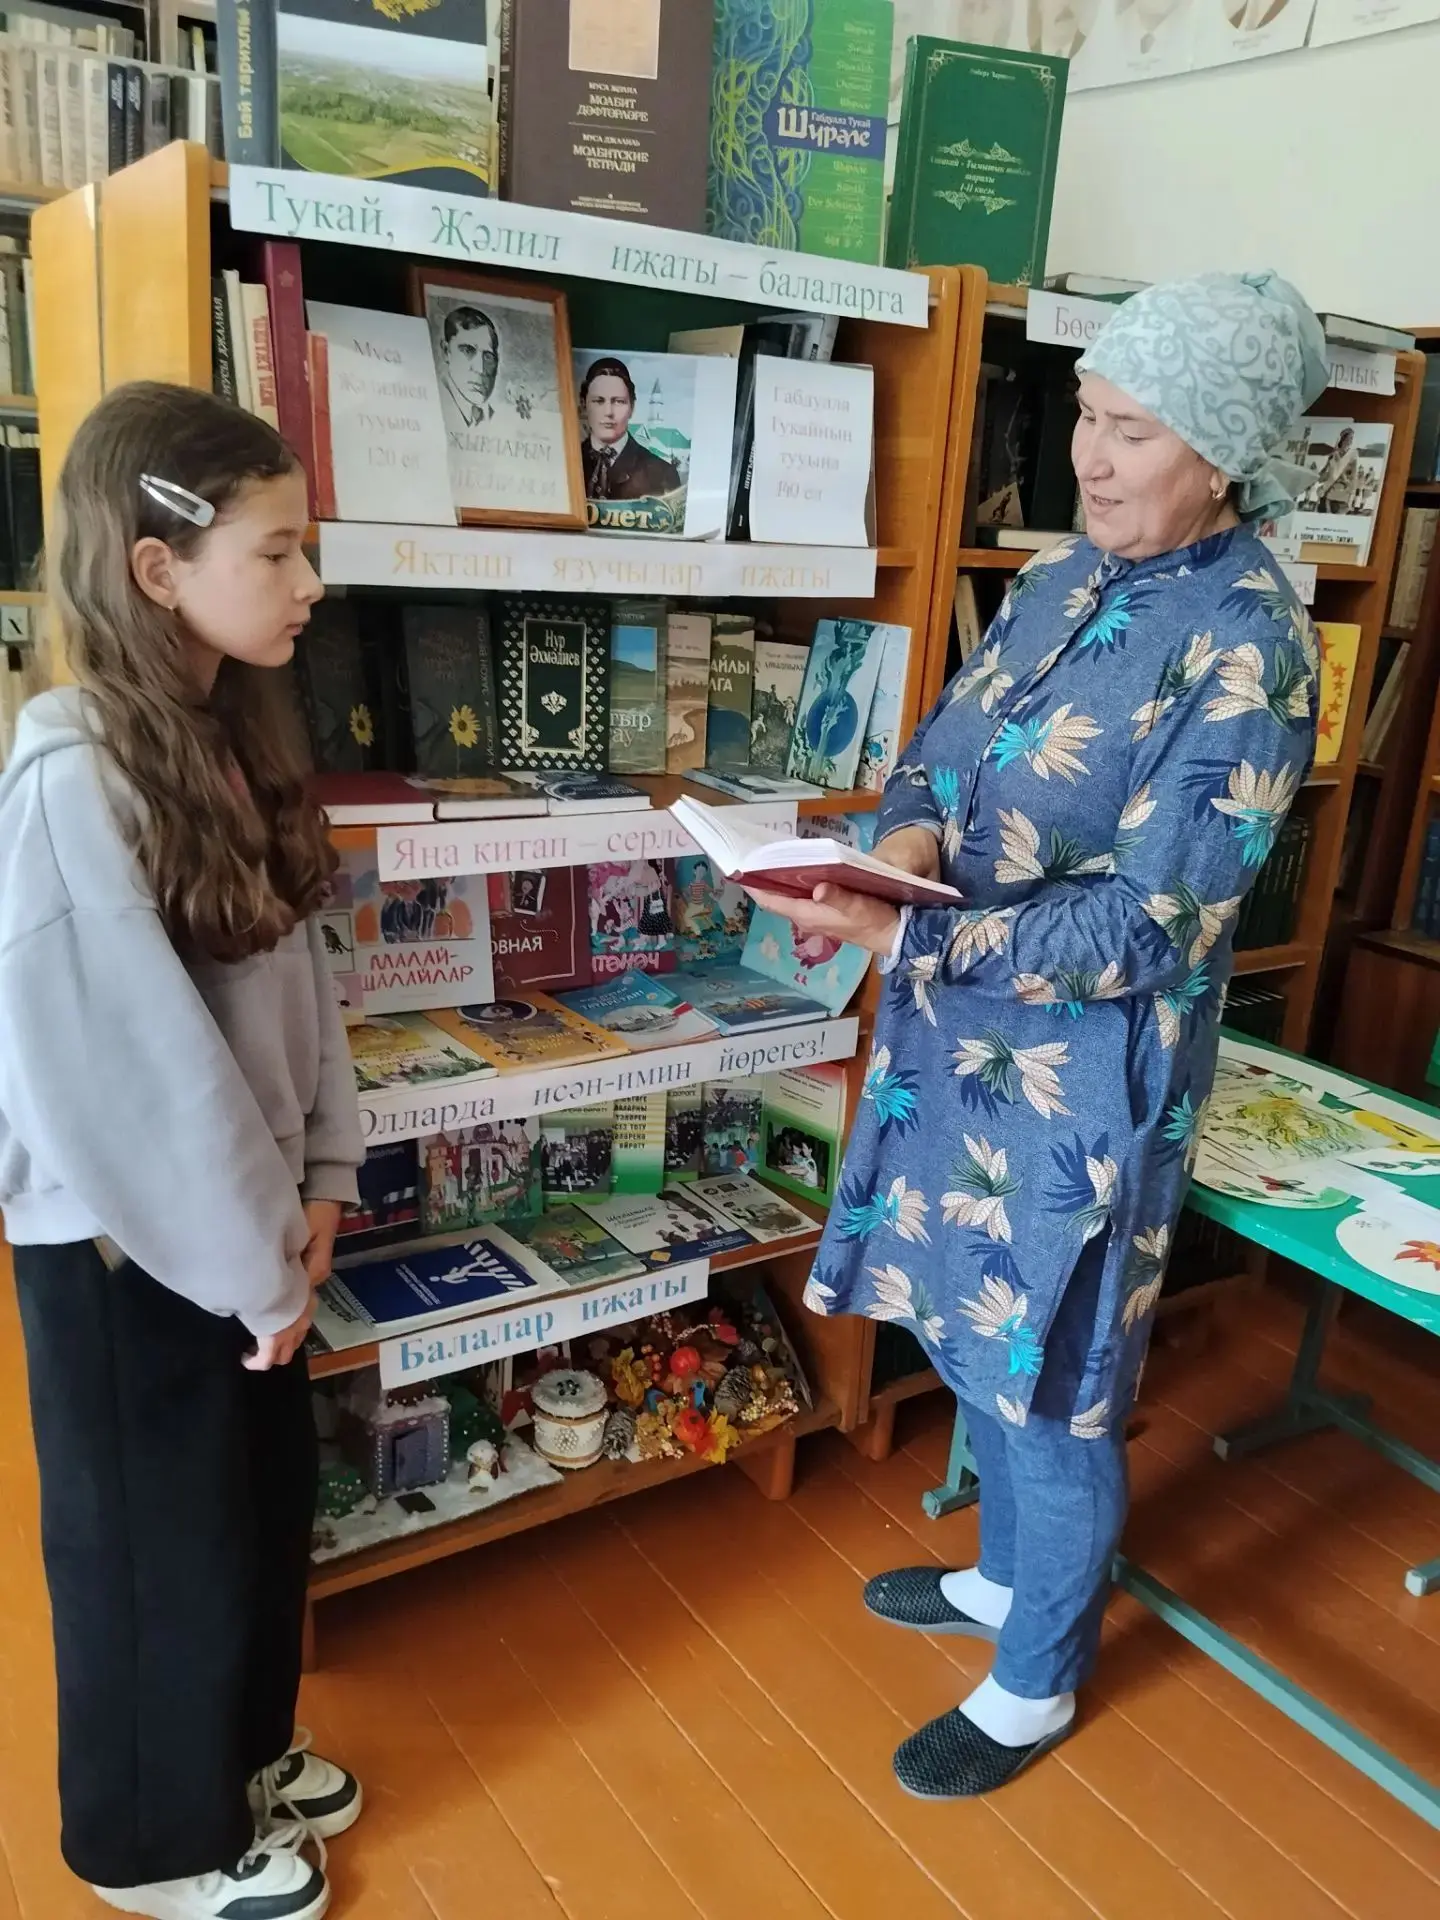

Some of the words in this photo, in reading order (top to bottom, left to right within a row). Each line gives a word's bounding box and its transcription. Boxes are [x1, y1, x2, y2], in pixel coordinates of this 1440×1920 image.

[589, 94, 637, 109] МОАБИТ
[237, 102, 253, 139] Бай
[811, 112, 847, 126] Габдулла
[847, 116, 871, 129] Тукай
[572, 144, 650, 162] МОАБИТСКИЕ
[586, 157, 636, 173] ТЕТРАДИ
[256, 181, 396, 248] Тукай,
[431, 205, 563, 261] Җәлил
[758, 260, 905, 317] балаларга
[213, 297, 230, 358] ДЖАЛИЛЯ
[1053, 306, 1102, 341] Бөе
[352, 338, 403, 365] Муса
[219, 360, 233, 397] МУСЫ
[773, 385, 851, 414] Габдулла
[367, 446, 396, 468] 120
[780, 450, 840, 473] тууына
[391, 539, 513, 579] Якташ
[552, 555, 704, 595] язучылар
[545, 629, 567, 652] Нур
[529, 645, 581, 667] Әхмәдиев
[392, 838, 460, 872] Яңа
[473, 835, 569, 866] китап
[369, 945, 460, 972] МАЛАЙ-
[533, 1061, 692, 1107] исән-имин
[718, 1030, 827, 1078] йөрегез!
[399, 1309, 554, 1373] Балалар
